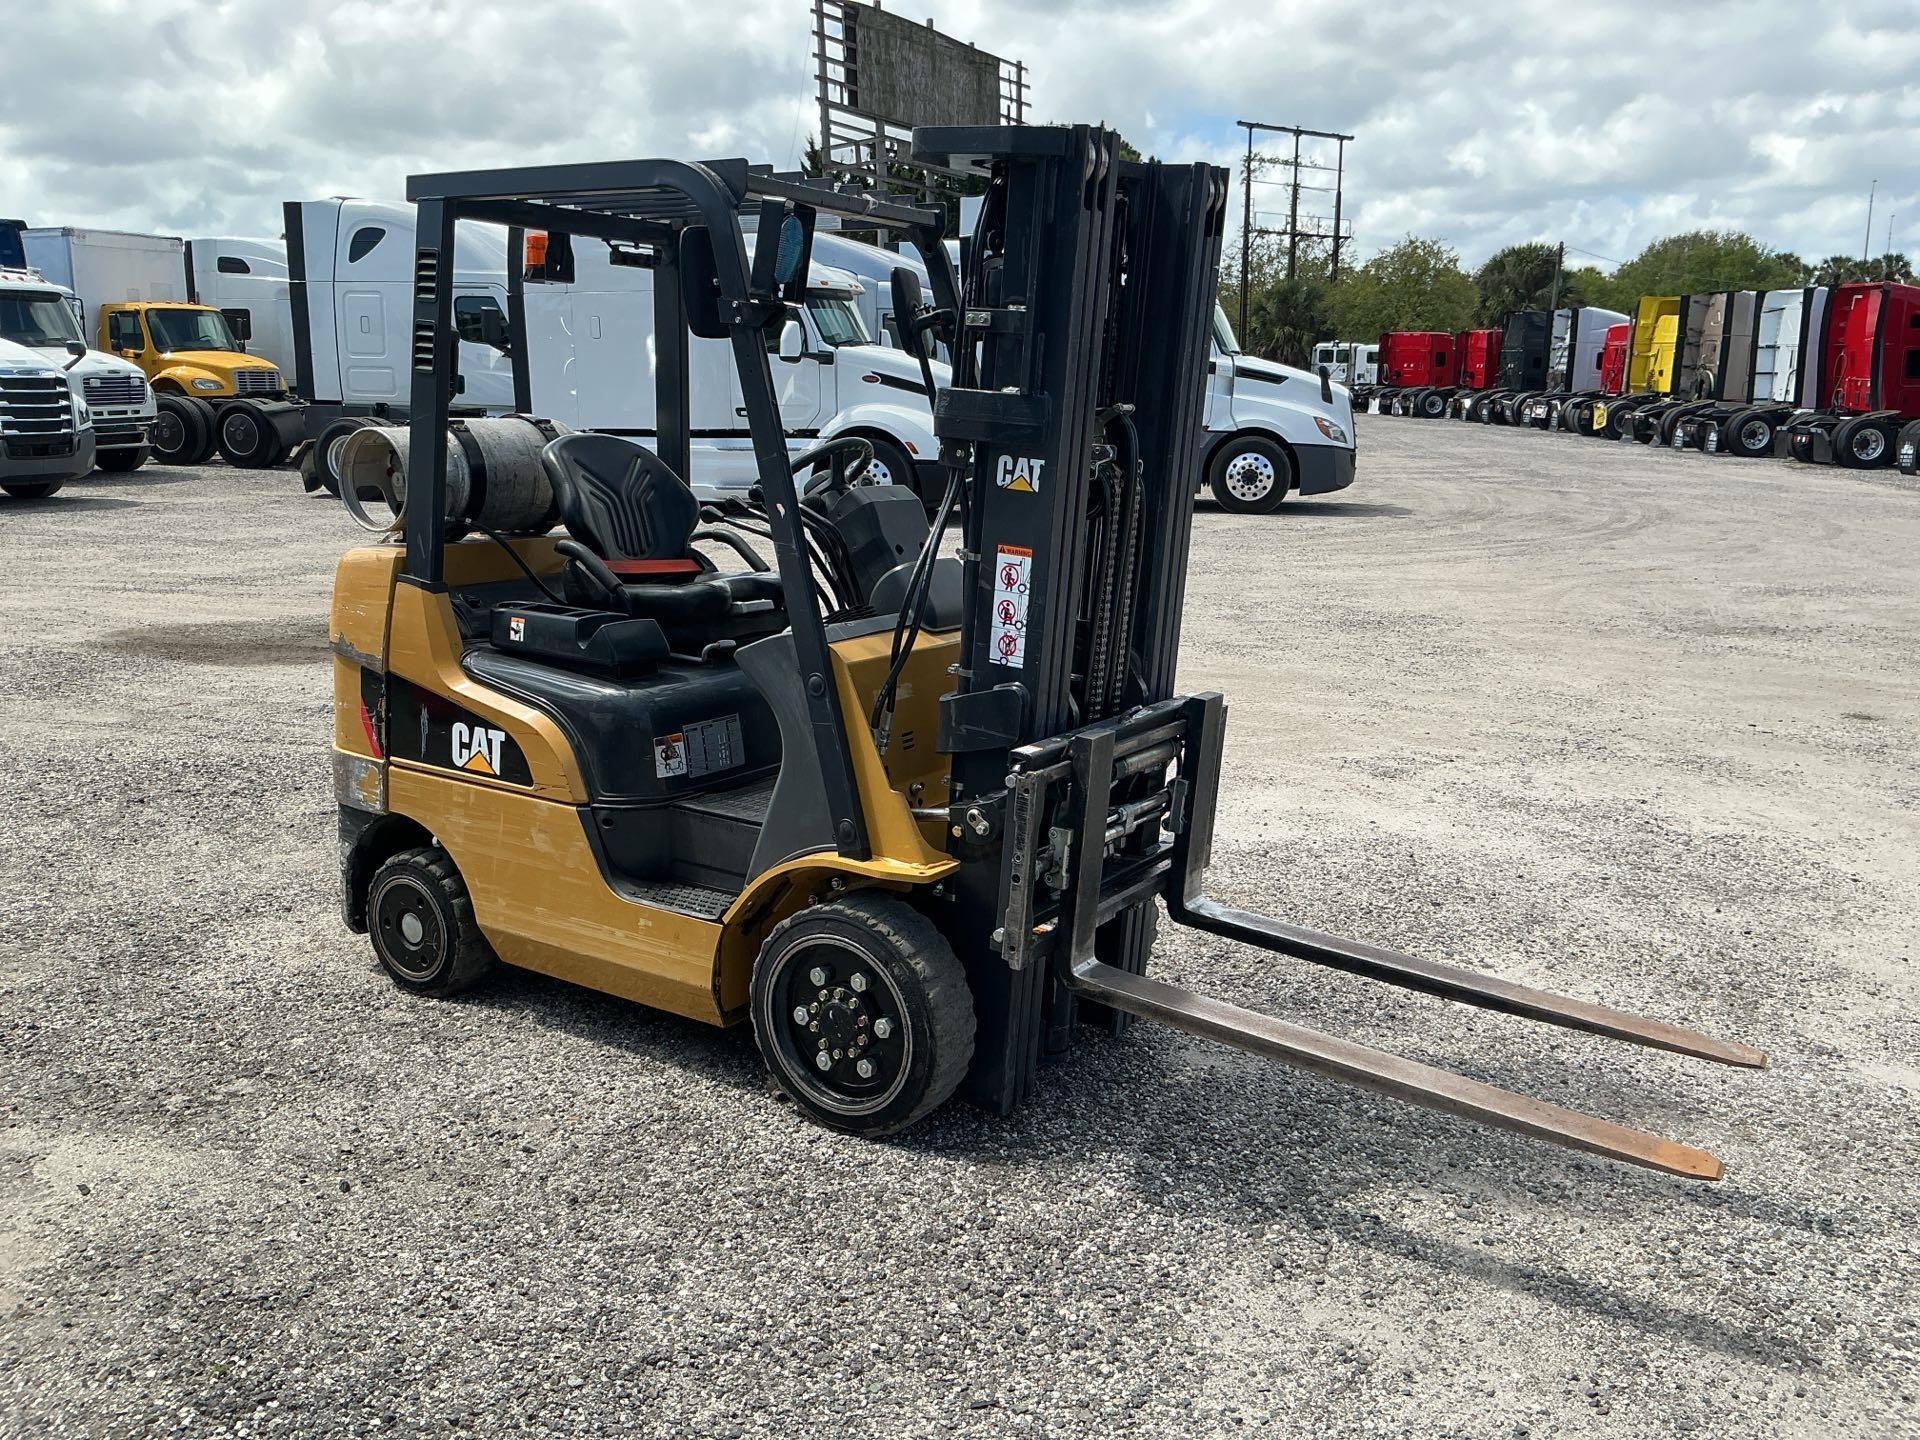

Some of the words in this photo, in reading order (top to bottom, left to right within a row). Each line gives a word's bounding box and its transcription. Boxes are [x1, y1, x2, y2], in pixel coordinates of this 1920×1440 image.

[996, 454, 1046, 493] CAT
[1007, 548, 1031, 557] WARNING
[451, 722, 506, 776] CAT
